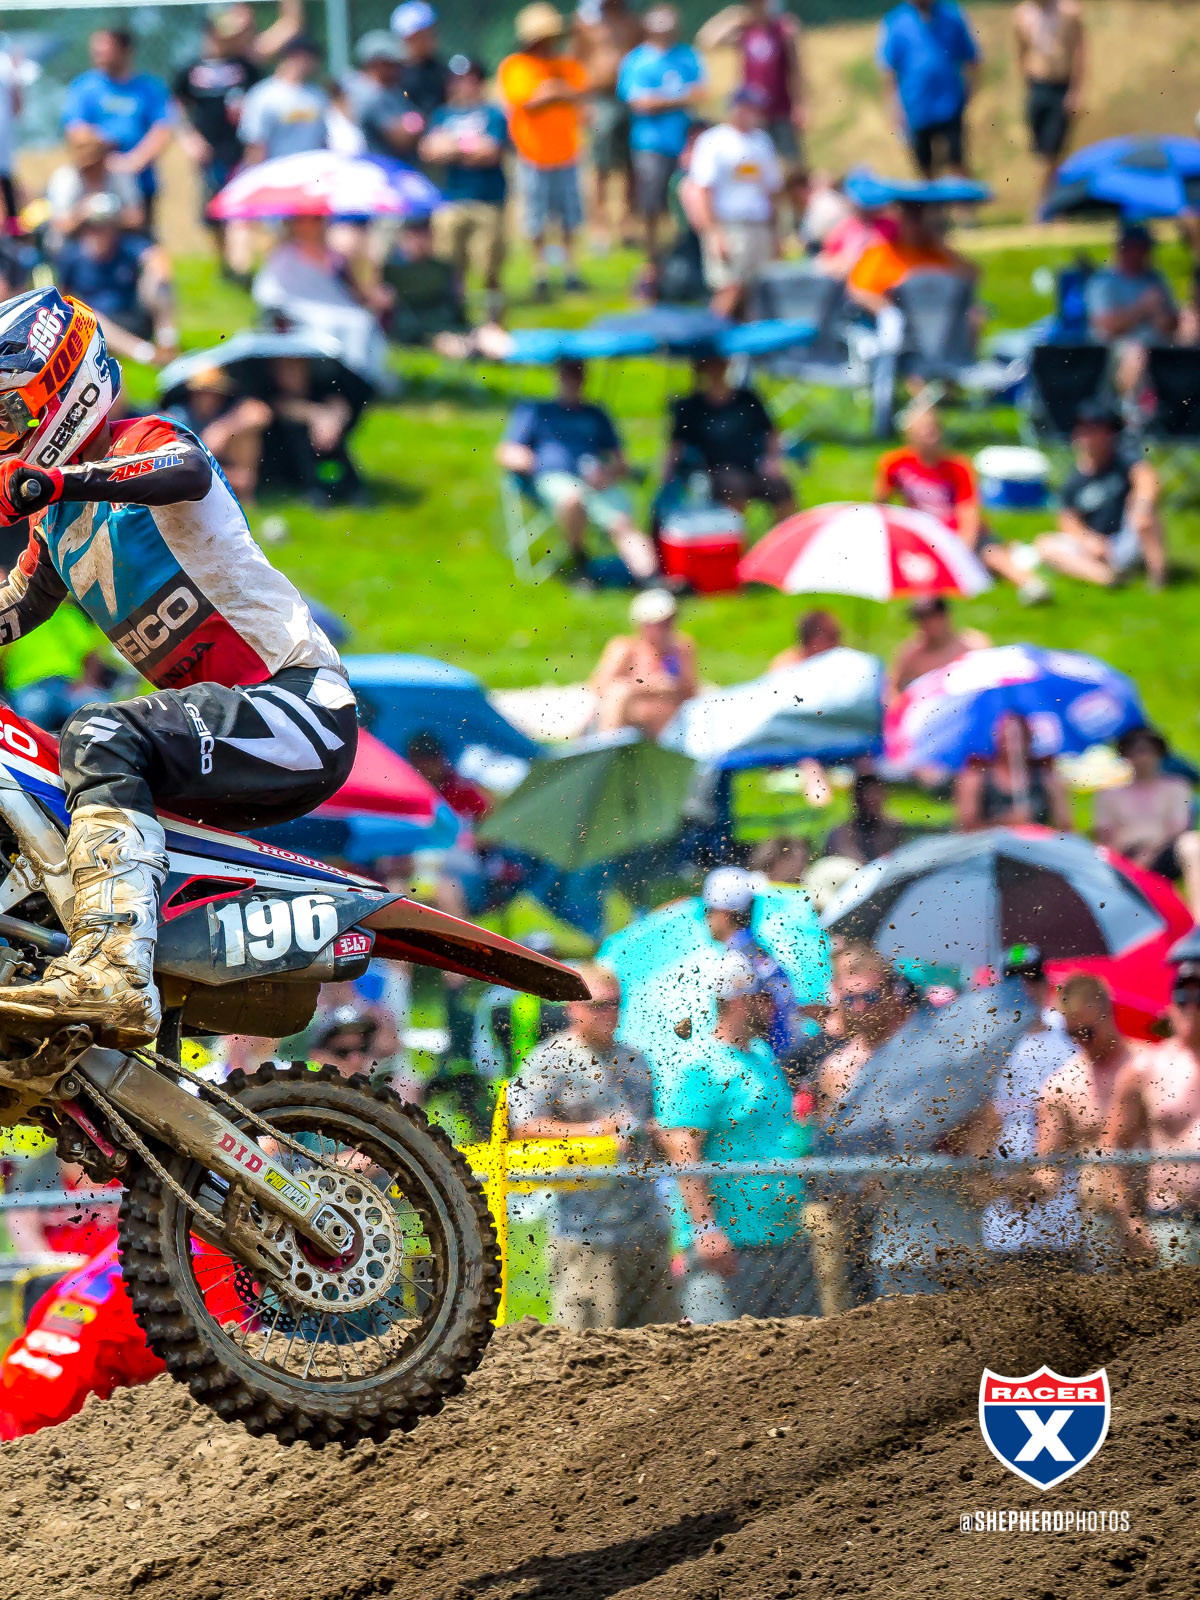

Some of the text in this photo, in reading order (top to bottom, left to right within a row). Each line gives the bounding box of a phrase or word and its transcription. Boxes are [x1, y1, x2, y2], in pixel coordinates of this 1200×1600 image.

[29, 307, 63, 360] 196
[37, 382, 100, 468] GEICO
[107, 454, 184, 483] AMSOIL
[184, 703, 215, 775] GEICO
[261, 845, 349, 877] HONDA
[215, 894, 338, 967] 196
